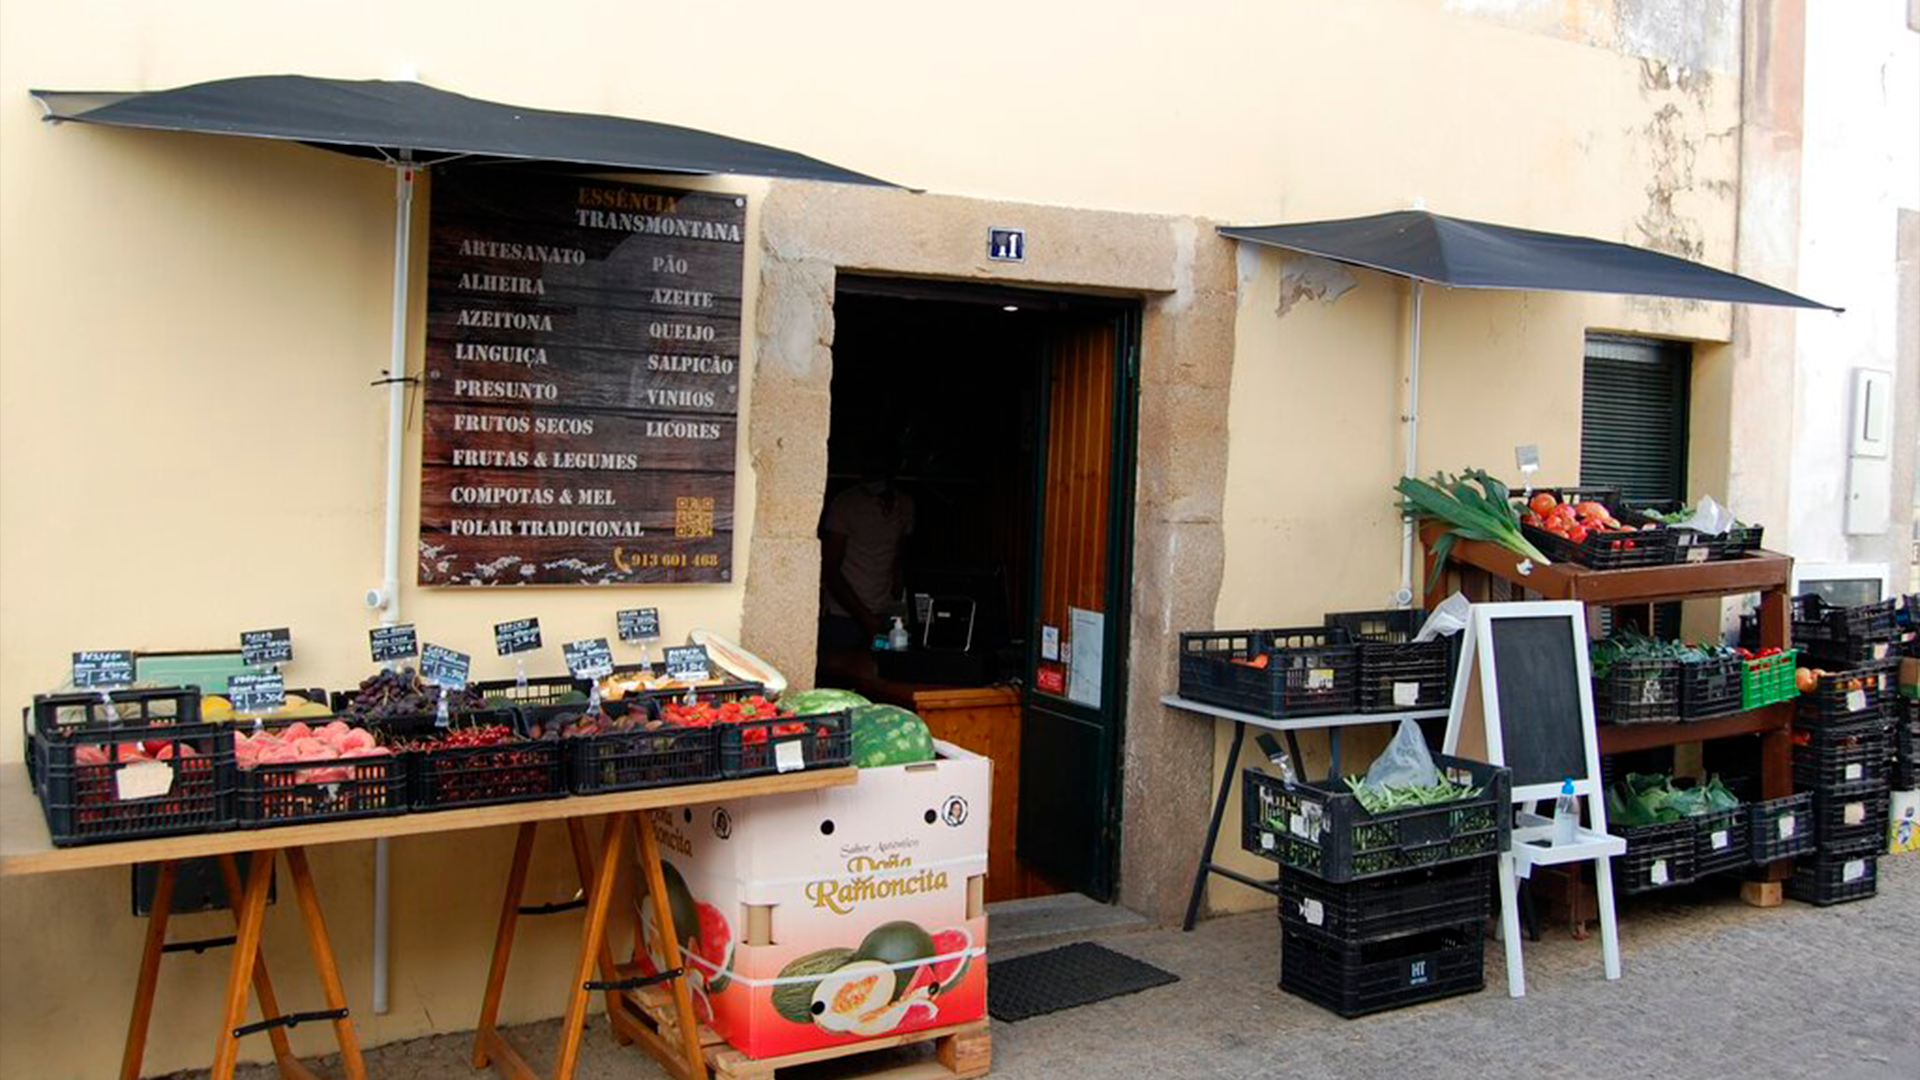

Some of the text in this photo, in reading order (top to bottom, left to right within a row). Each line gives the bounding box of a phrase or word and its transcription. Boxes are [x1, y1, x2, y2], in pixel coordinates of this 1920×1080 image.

[577, 186, 678, 213] ESSÊNCIA
[576, 209, 741, 242] TRANSMONTANA
[459, 239, 586, 266] ARTESANATO
[652, 254, 688, 275] PÃO
[458, 273, 545, 295] ALHEIRA
[650, 288, 714, 308] AZEITE
[456, 309, 553, 332] AZEITONA
[650, 322, 715, 342] QUEIJO
[455, 343, 548, 368] LINGUIÇA
[647, 354, 734, 374] SALPICÃO
[454, 379, 558, 400] PRESUNTO
[647, 389, 715, 408] VINHOS
[454, 414, 594, 435] FRUTOS SECOS
[646, 422, 720, 440] LICORES
[452, 449, 638, 470] FRUTAS & LEGUMES
[451, 486, 616, 506] COMPOTAS & MEL
[451, 519, 645, 538] FOLAR TRADICIONAL
[631, 552, 720, 569] 913 601 468
[805, 869, 948, 915] Ramoncita
